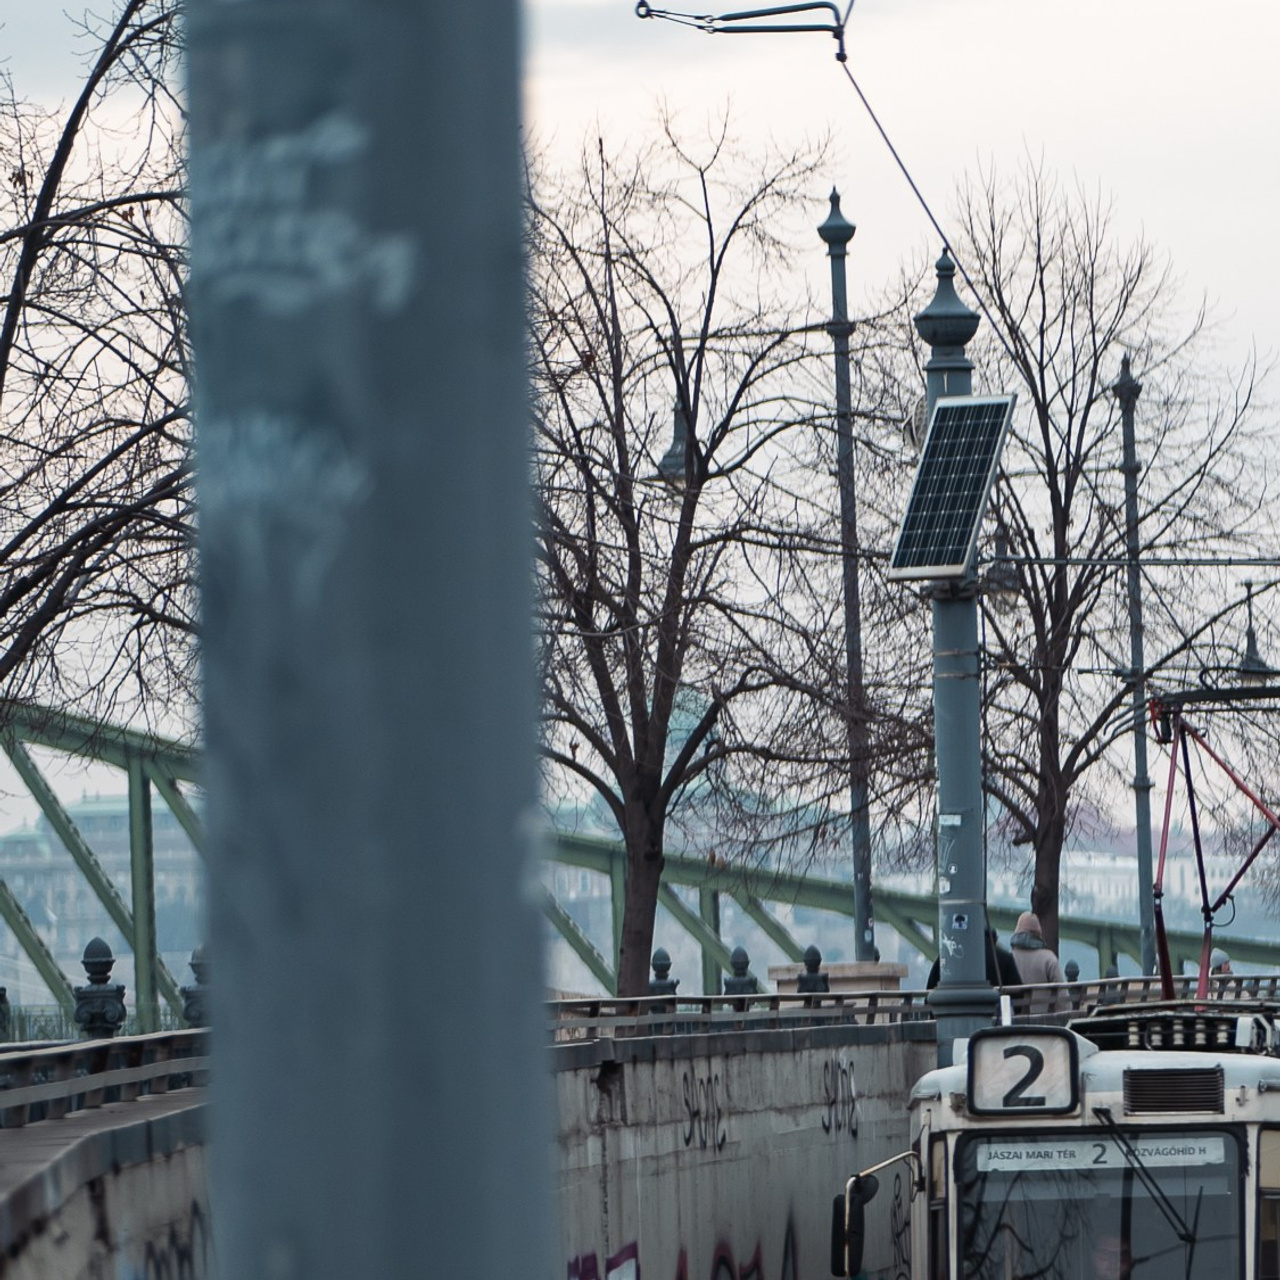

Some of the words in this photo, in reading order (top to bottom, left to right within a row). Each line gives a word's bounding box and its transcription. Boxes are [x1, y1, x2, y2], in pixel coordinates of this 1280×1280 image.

[1002, 1044, 1046, 1107] 2
[1026, 1150, 1054, 1160] MARI
[1056, 1148, 1077, 1159] TÉR
[1092, 1143, 1108, 1164] 2
[1198, 1146, 1207, 1155] H
